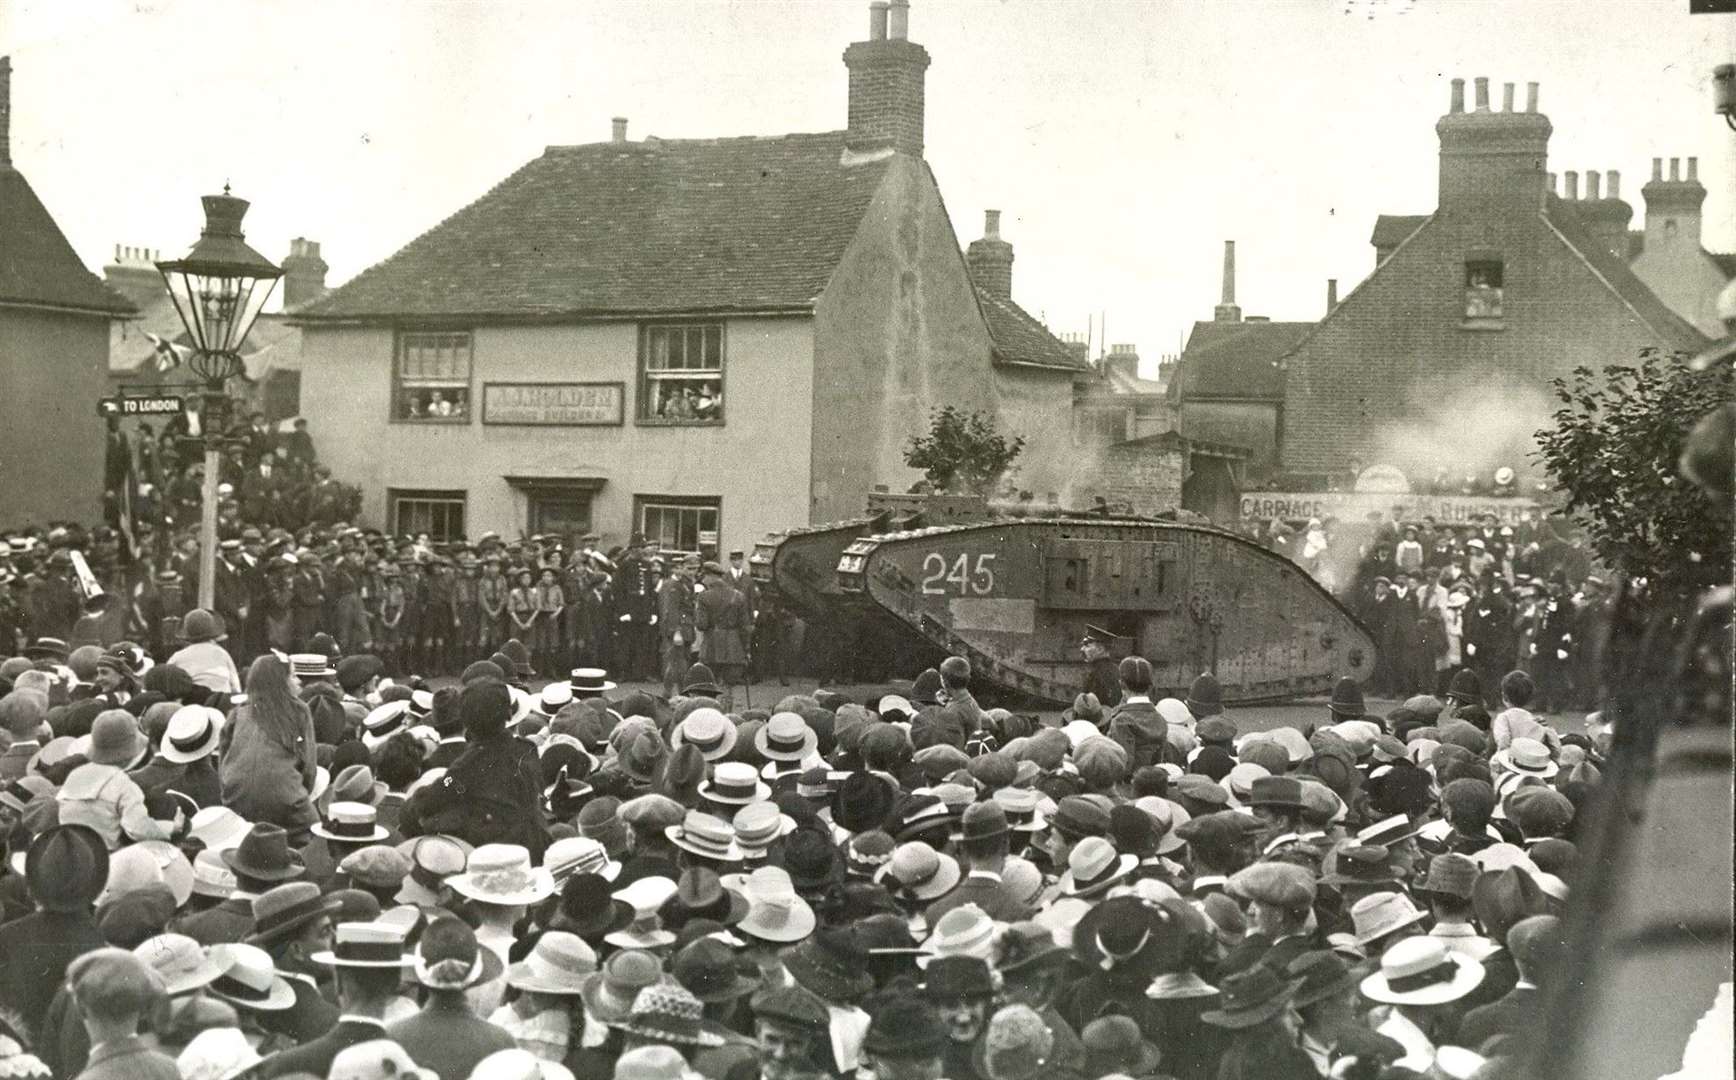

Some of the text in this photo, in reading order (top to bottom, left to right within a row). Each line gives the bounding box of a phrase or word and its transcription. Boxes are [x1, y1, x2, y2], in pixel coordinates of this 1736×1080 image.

[124, 399, 179, 412] TO LONDON
[922, 552, 996, 594] 245
